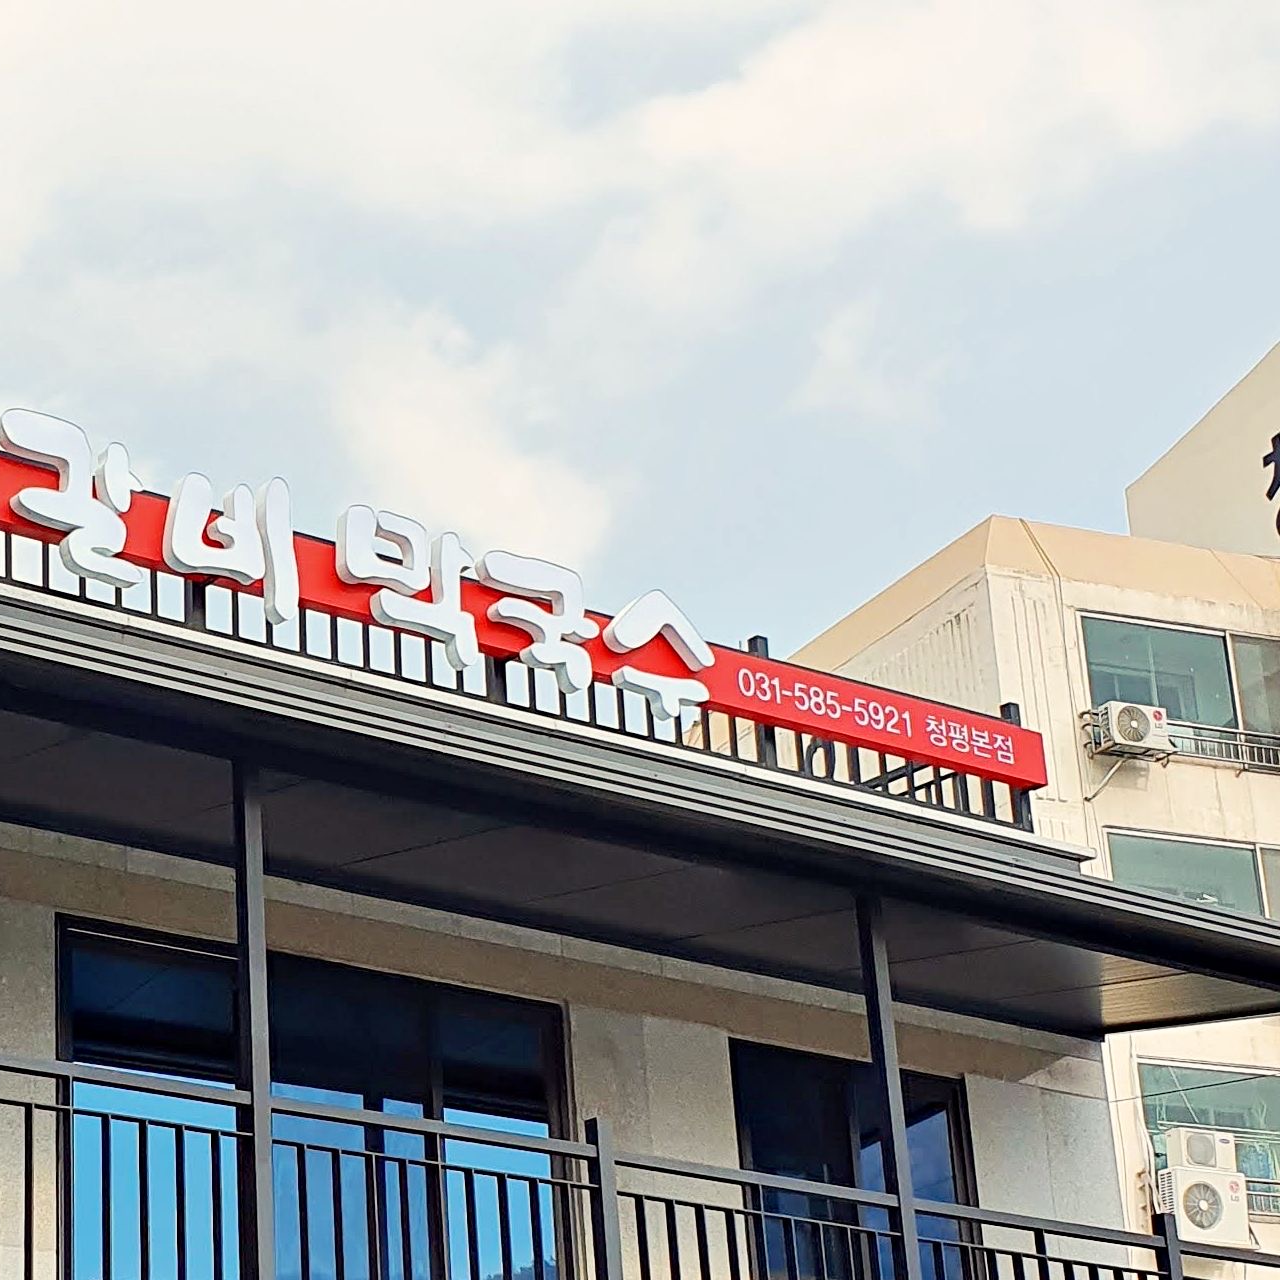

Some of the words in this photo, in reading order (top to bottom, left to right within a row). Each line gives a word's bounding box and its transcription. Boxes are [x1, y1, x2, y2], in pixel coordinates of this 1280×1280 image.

[336, 504, 715, 721] 막국수
[738, 668, 912, 738] 031-585-5921
[925, 714, 1015, 765] 청평본점
